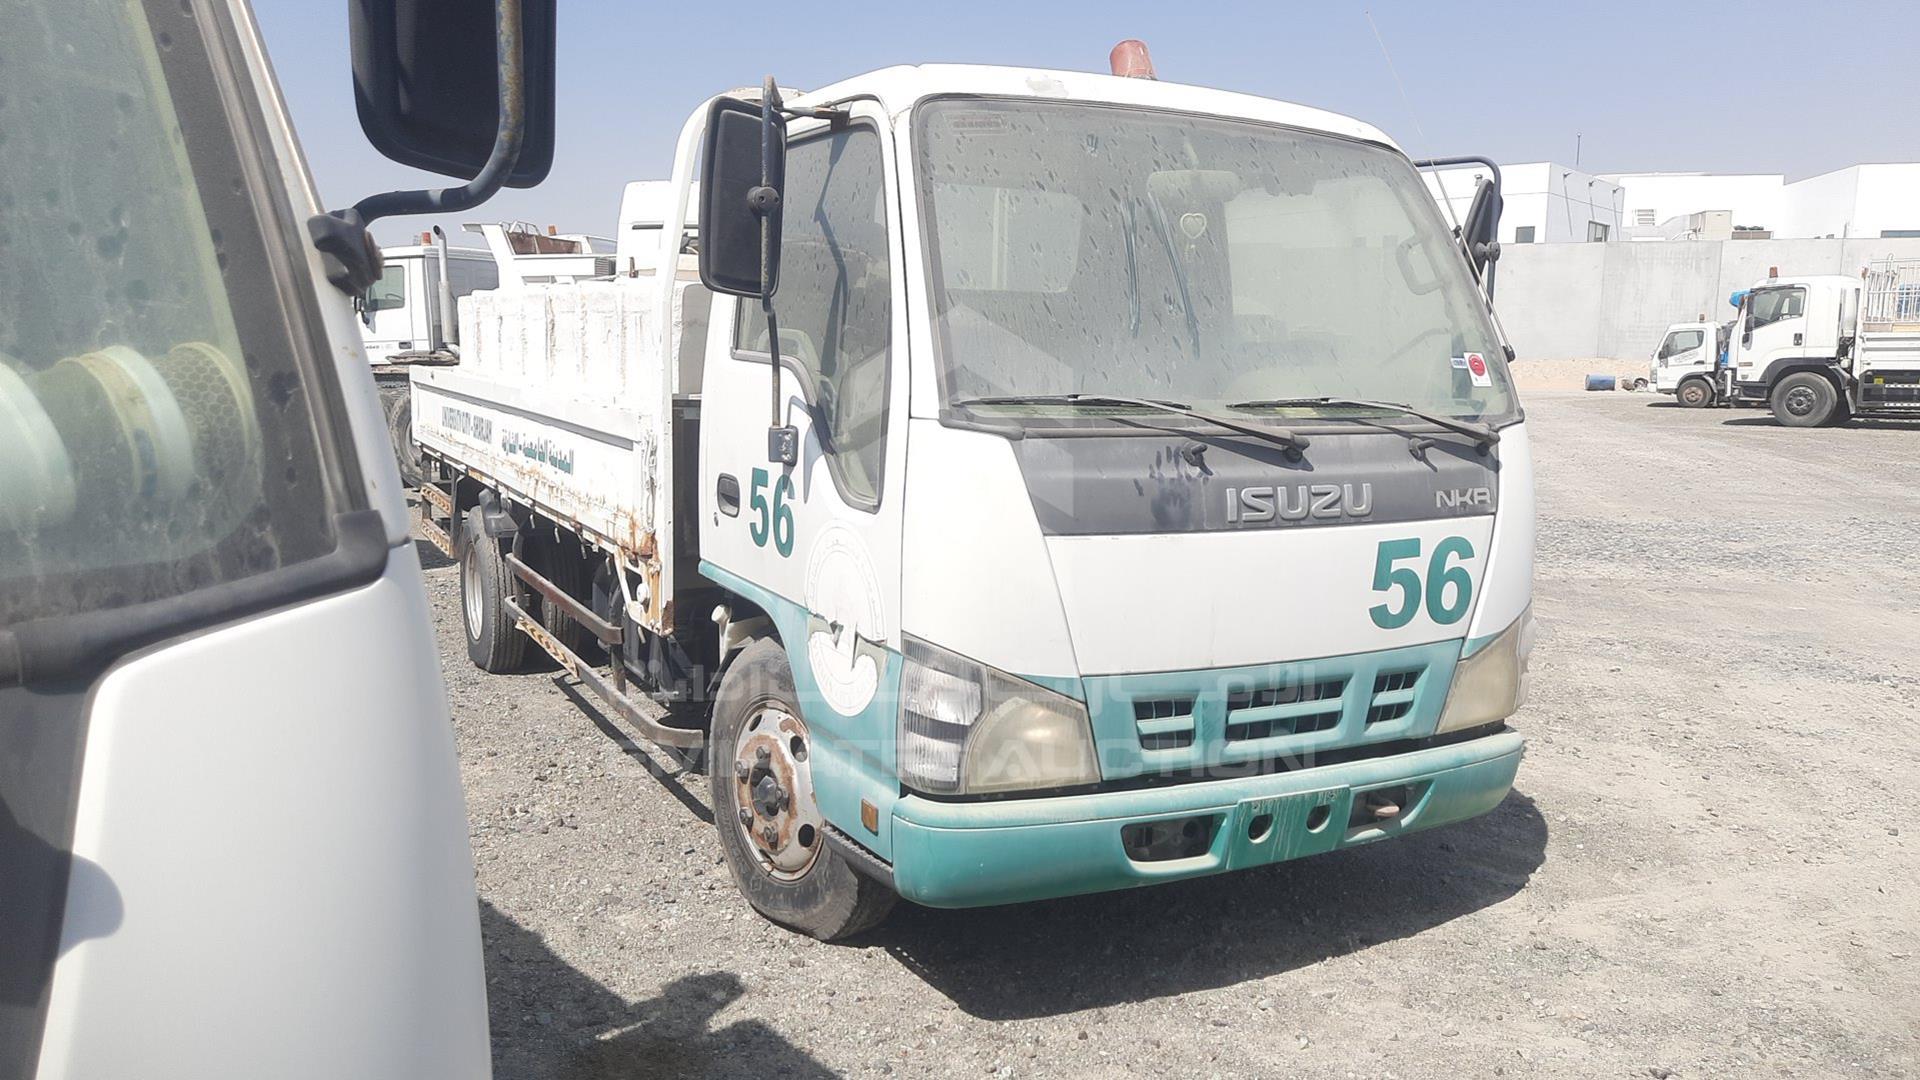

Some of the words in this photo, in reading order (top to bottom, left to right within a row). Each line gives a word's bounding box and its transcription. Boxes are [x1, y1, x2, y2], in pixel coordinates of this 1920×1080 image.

[441, 406, 461, 432] UNIVERSITY
[462, 411, 471, 436] CITY
[473, 414, 493, 444] SHARJAH
[749, 467, 795, 558] 56
[1226, 483, 1373, 523] ISUZU
[1435, 487, 1492, 509] NKR
[1368, 536, 1475, 630] 56
